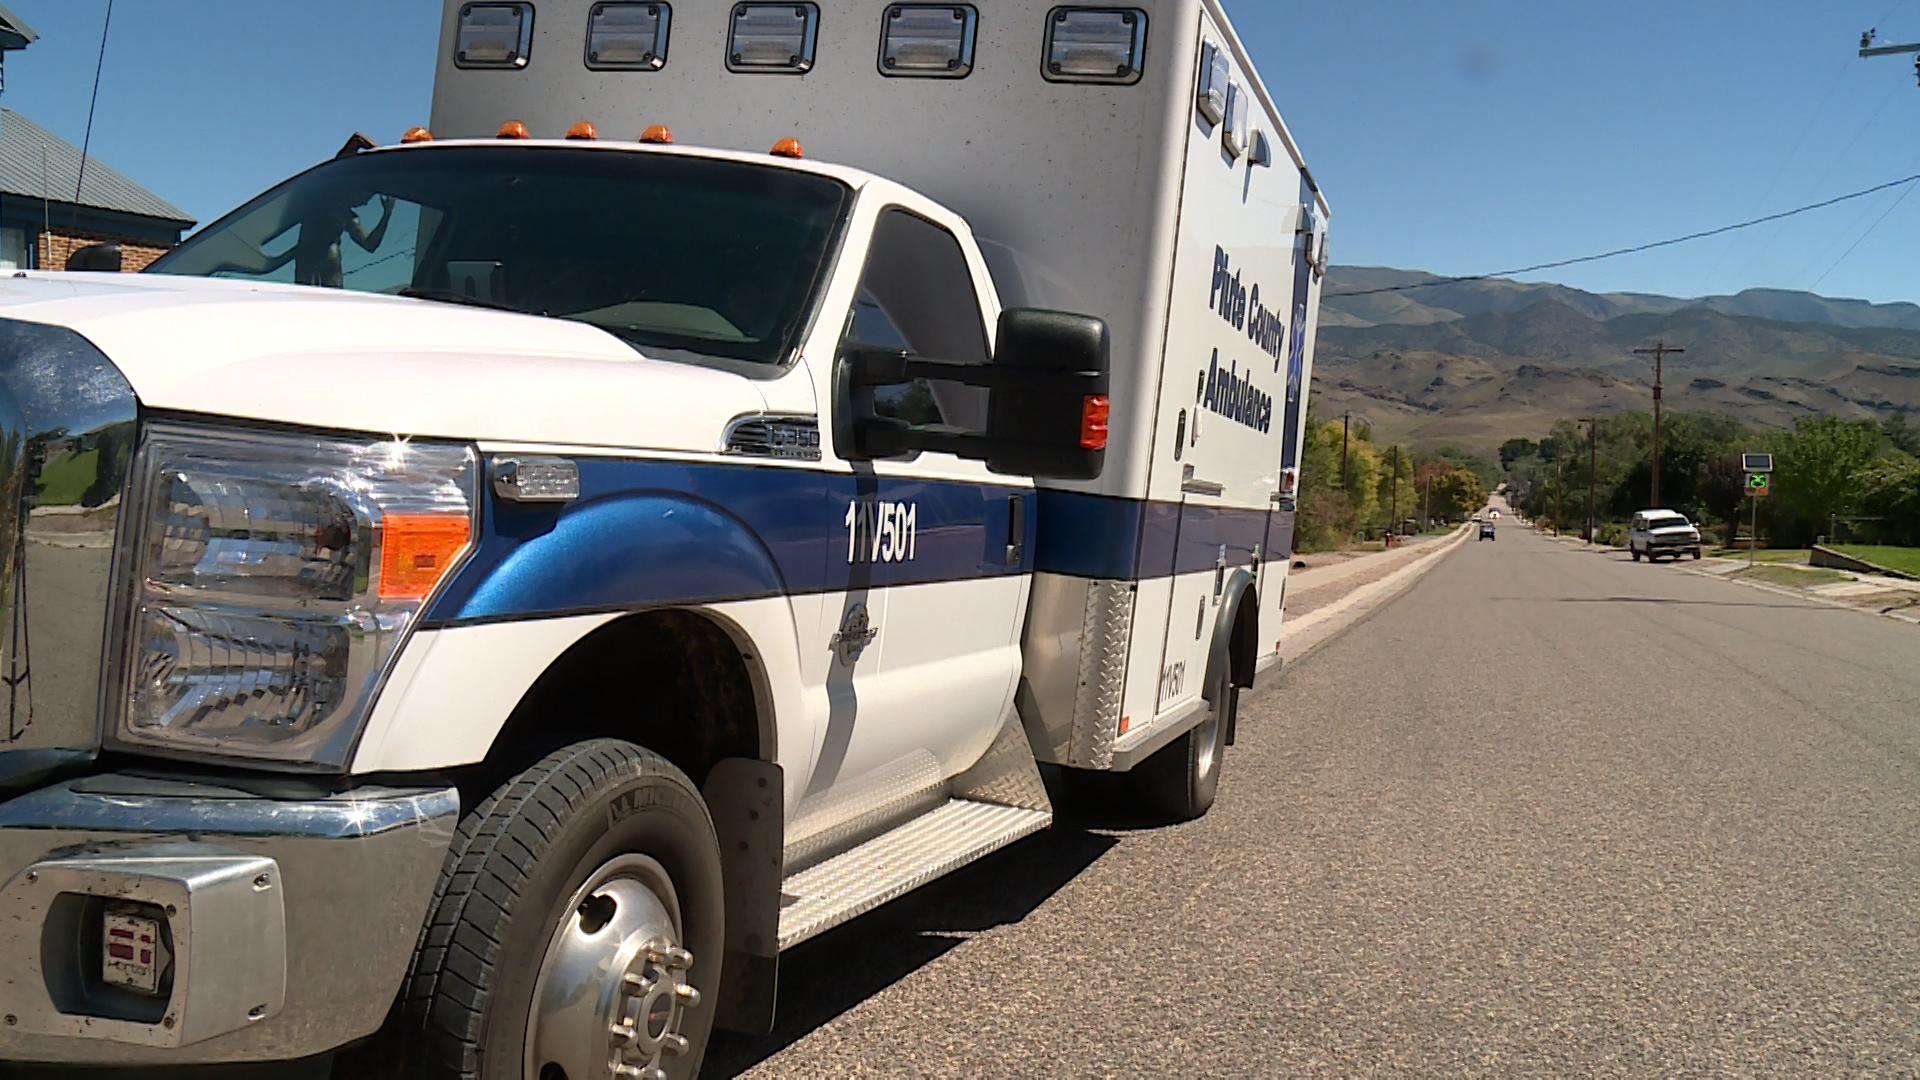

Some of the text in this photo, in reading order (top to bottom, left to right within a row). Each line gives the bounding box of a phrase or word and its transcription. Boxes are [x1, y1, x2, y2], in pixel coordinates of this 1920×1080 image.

[1209, 243, 1285, 373] Piute County
[1203, 347, 1272, 434] Ambulance
[845, 500, 917, 563] 11V501
